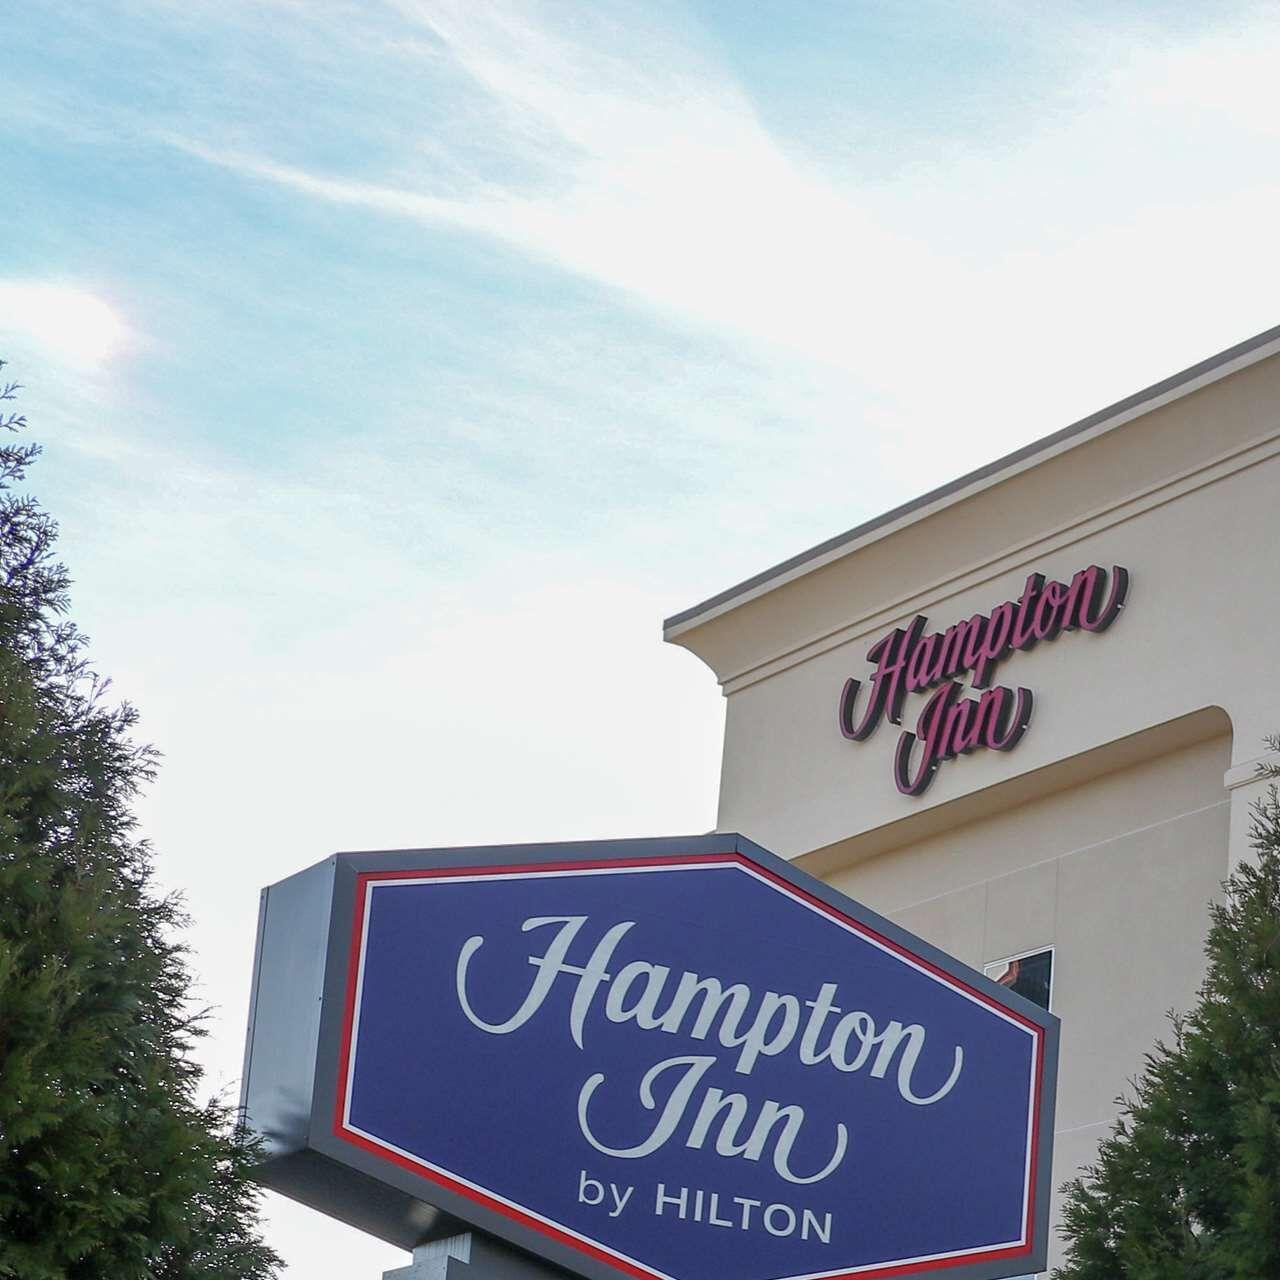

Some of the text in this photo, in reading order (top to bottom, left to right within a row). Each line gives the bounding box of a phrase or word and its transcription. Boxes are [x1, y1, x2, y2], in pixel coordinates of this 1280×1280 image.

[839, 564, 1129, 742] Hampton
[894, 680, 1034, 797] Inn
[456, 915, 963, 1105] Hampton
[577, 1055, 848, 1184] Inn
[577, 1169, 833, 1244] by HILTON
